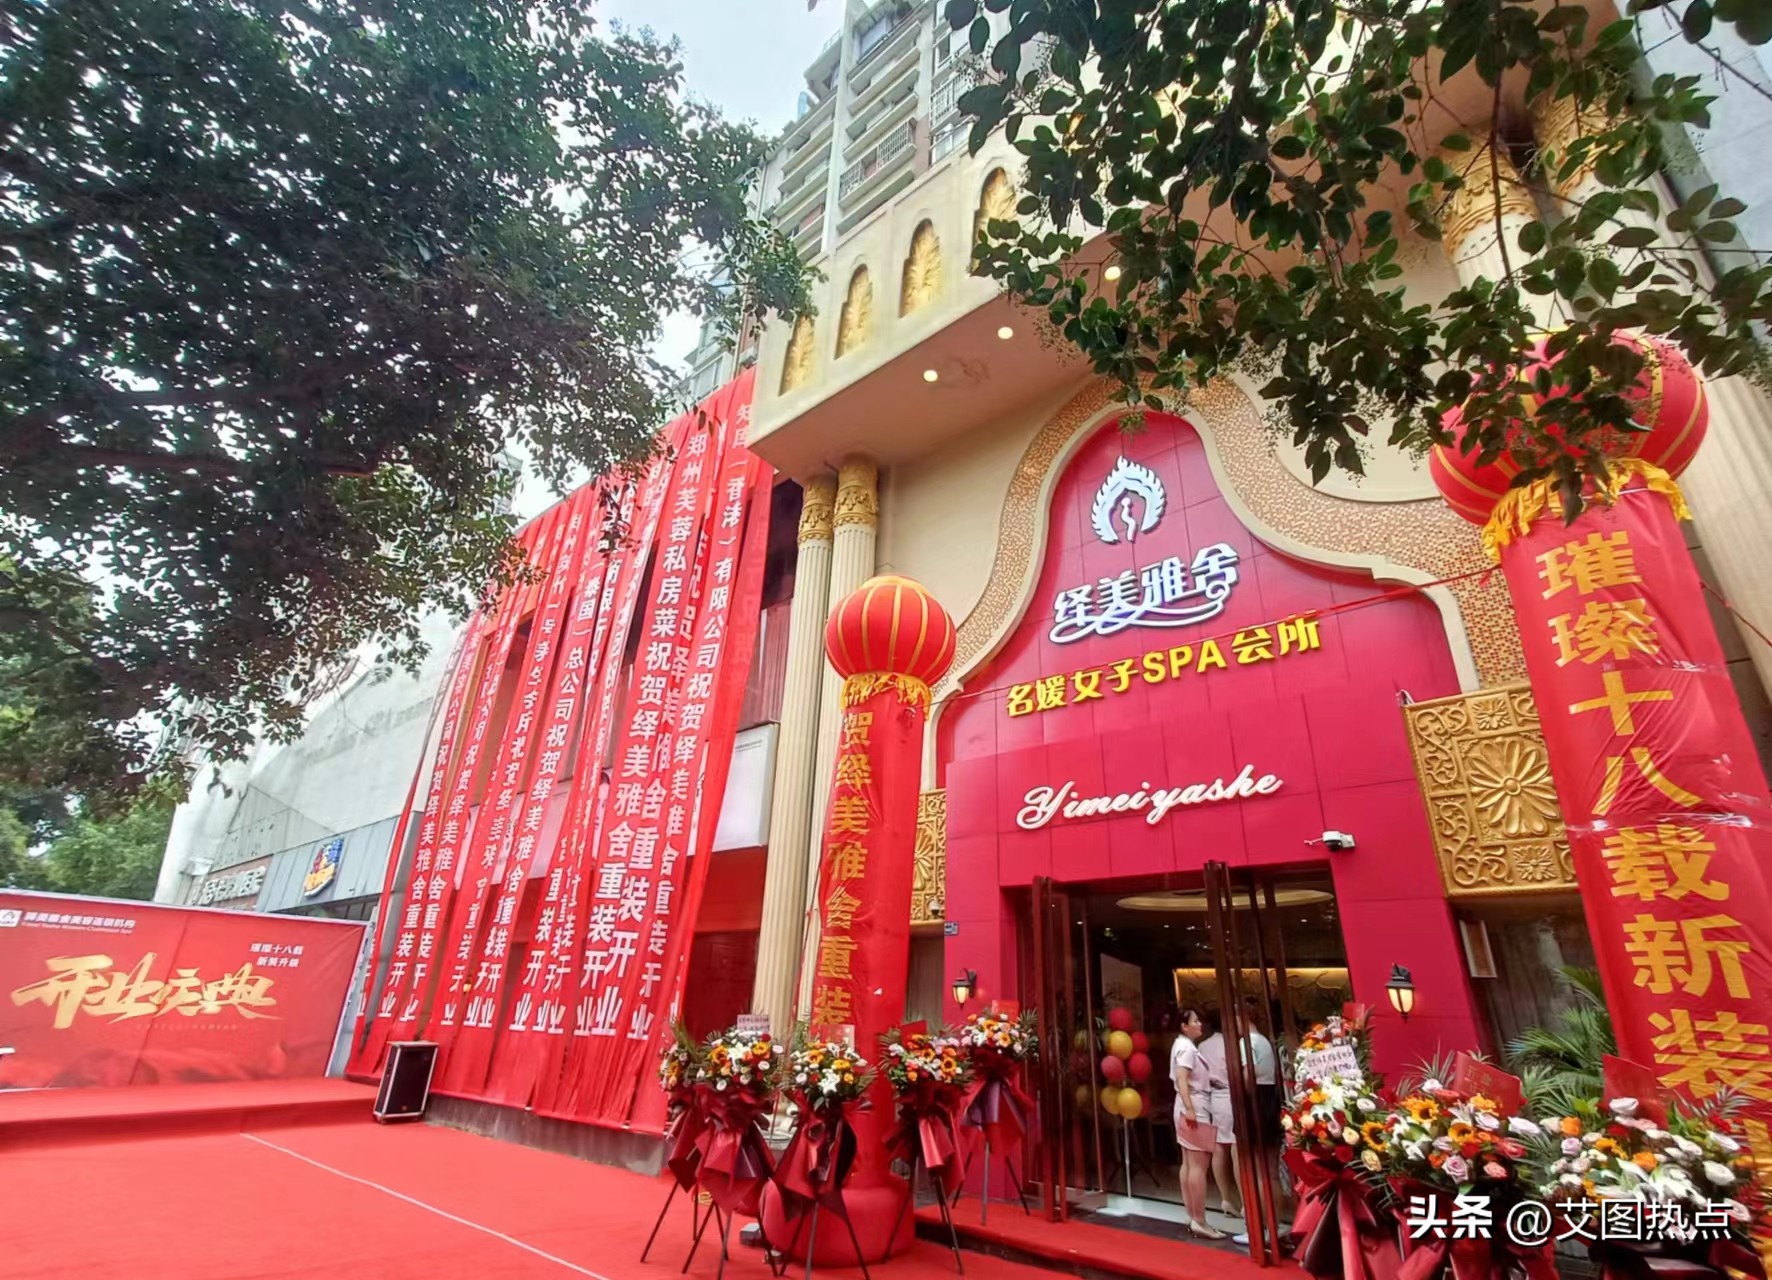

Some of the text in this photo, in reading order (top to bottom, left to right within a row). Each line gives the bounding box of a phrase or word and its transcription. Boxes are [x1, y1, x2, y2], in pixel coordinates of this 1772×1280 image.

[1049, 542, 1240, 642] 绎美雅舍
[1005, 616, 1322, 718] 名媛女子SPA会所
[814, 711, 874, 1027] 贺绎美雅舍重装
[1535, 530, 1772, 1280] 璀璨十八载新装
[11, 951, 284, 1029] 开业庆典
